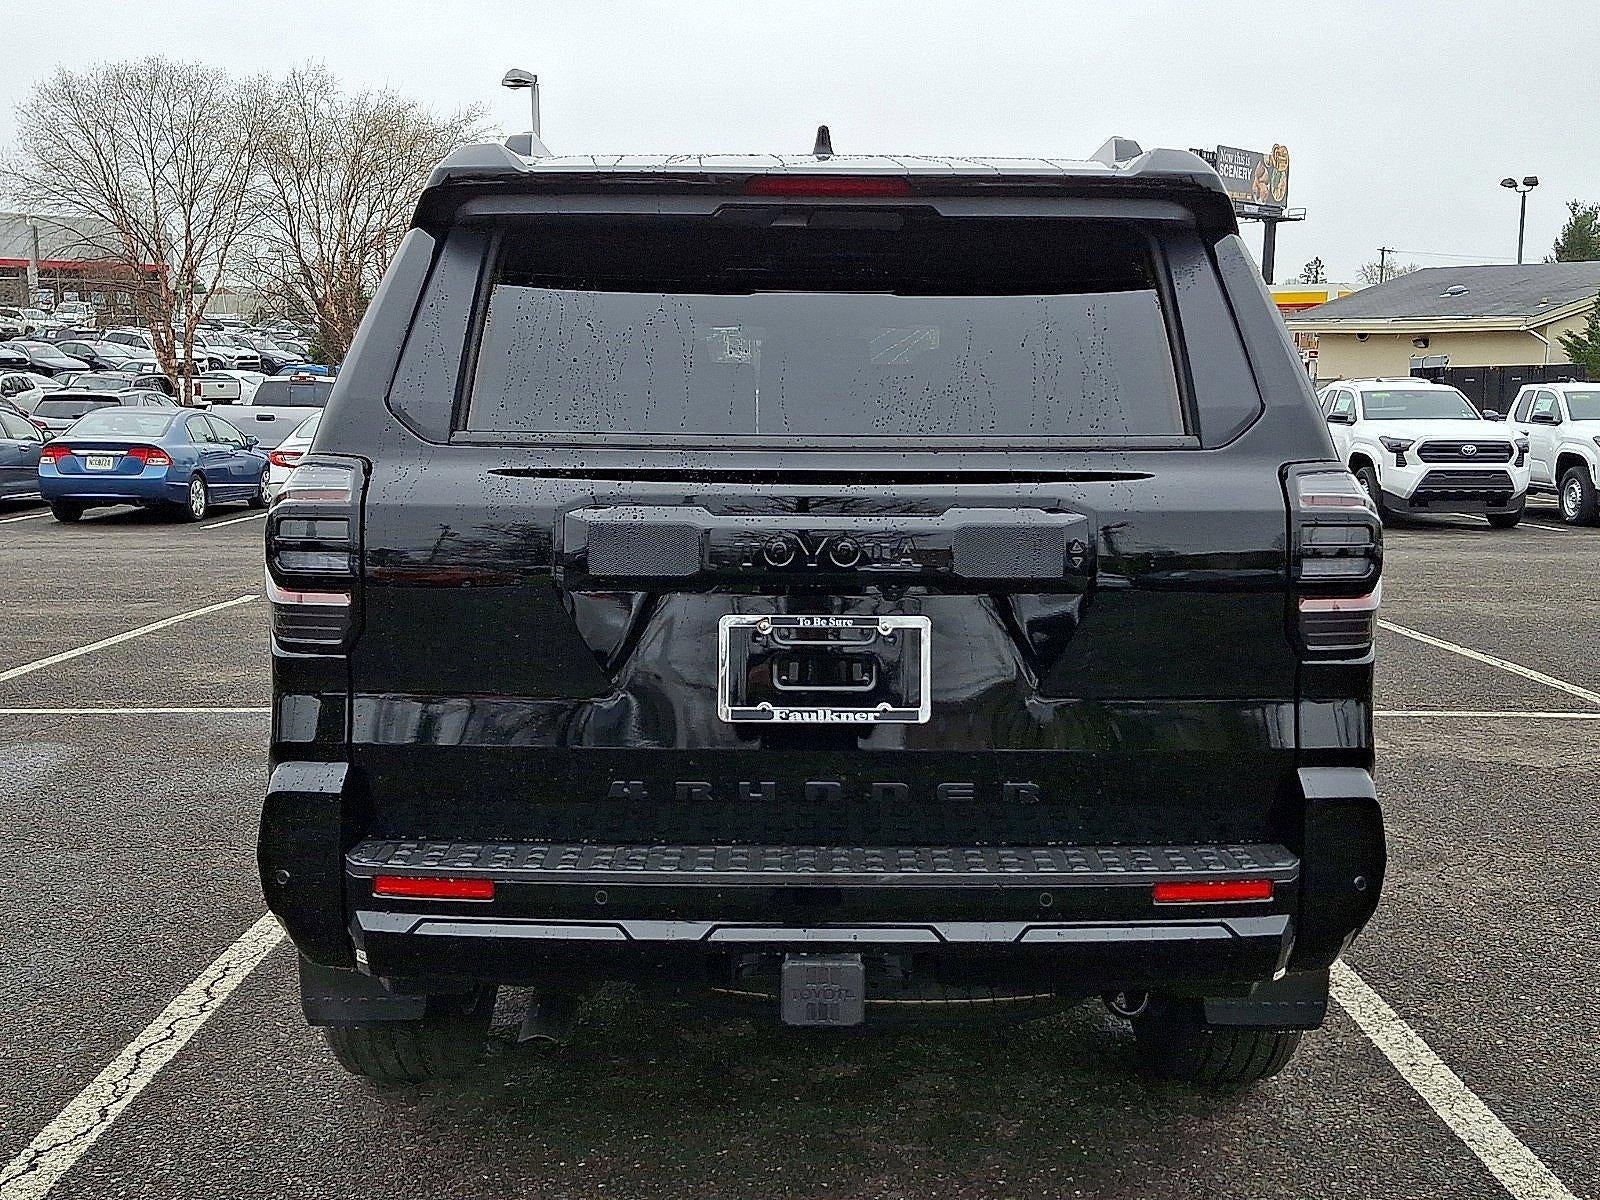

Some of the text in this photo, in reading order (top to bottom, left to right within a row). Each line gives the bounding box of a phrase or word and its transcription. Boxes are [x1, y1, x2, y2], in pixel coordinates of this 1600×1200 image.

[1219, 148, 1234, 163] Now
[1219, 163, 1252, 181] SCENERY
[733, 535, 923, 567] TOYOTA
[797, 617, 854, 626] To Be Sure
[771, 708, 880, 722] Faulkner
[607, 780, 1041, 801] 4RUNNER
